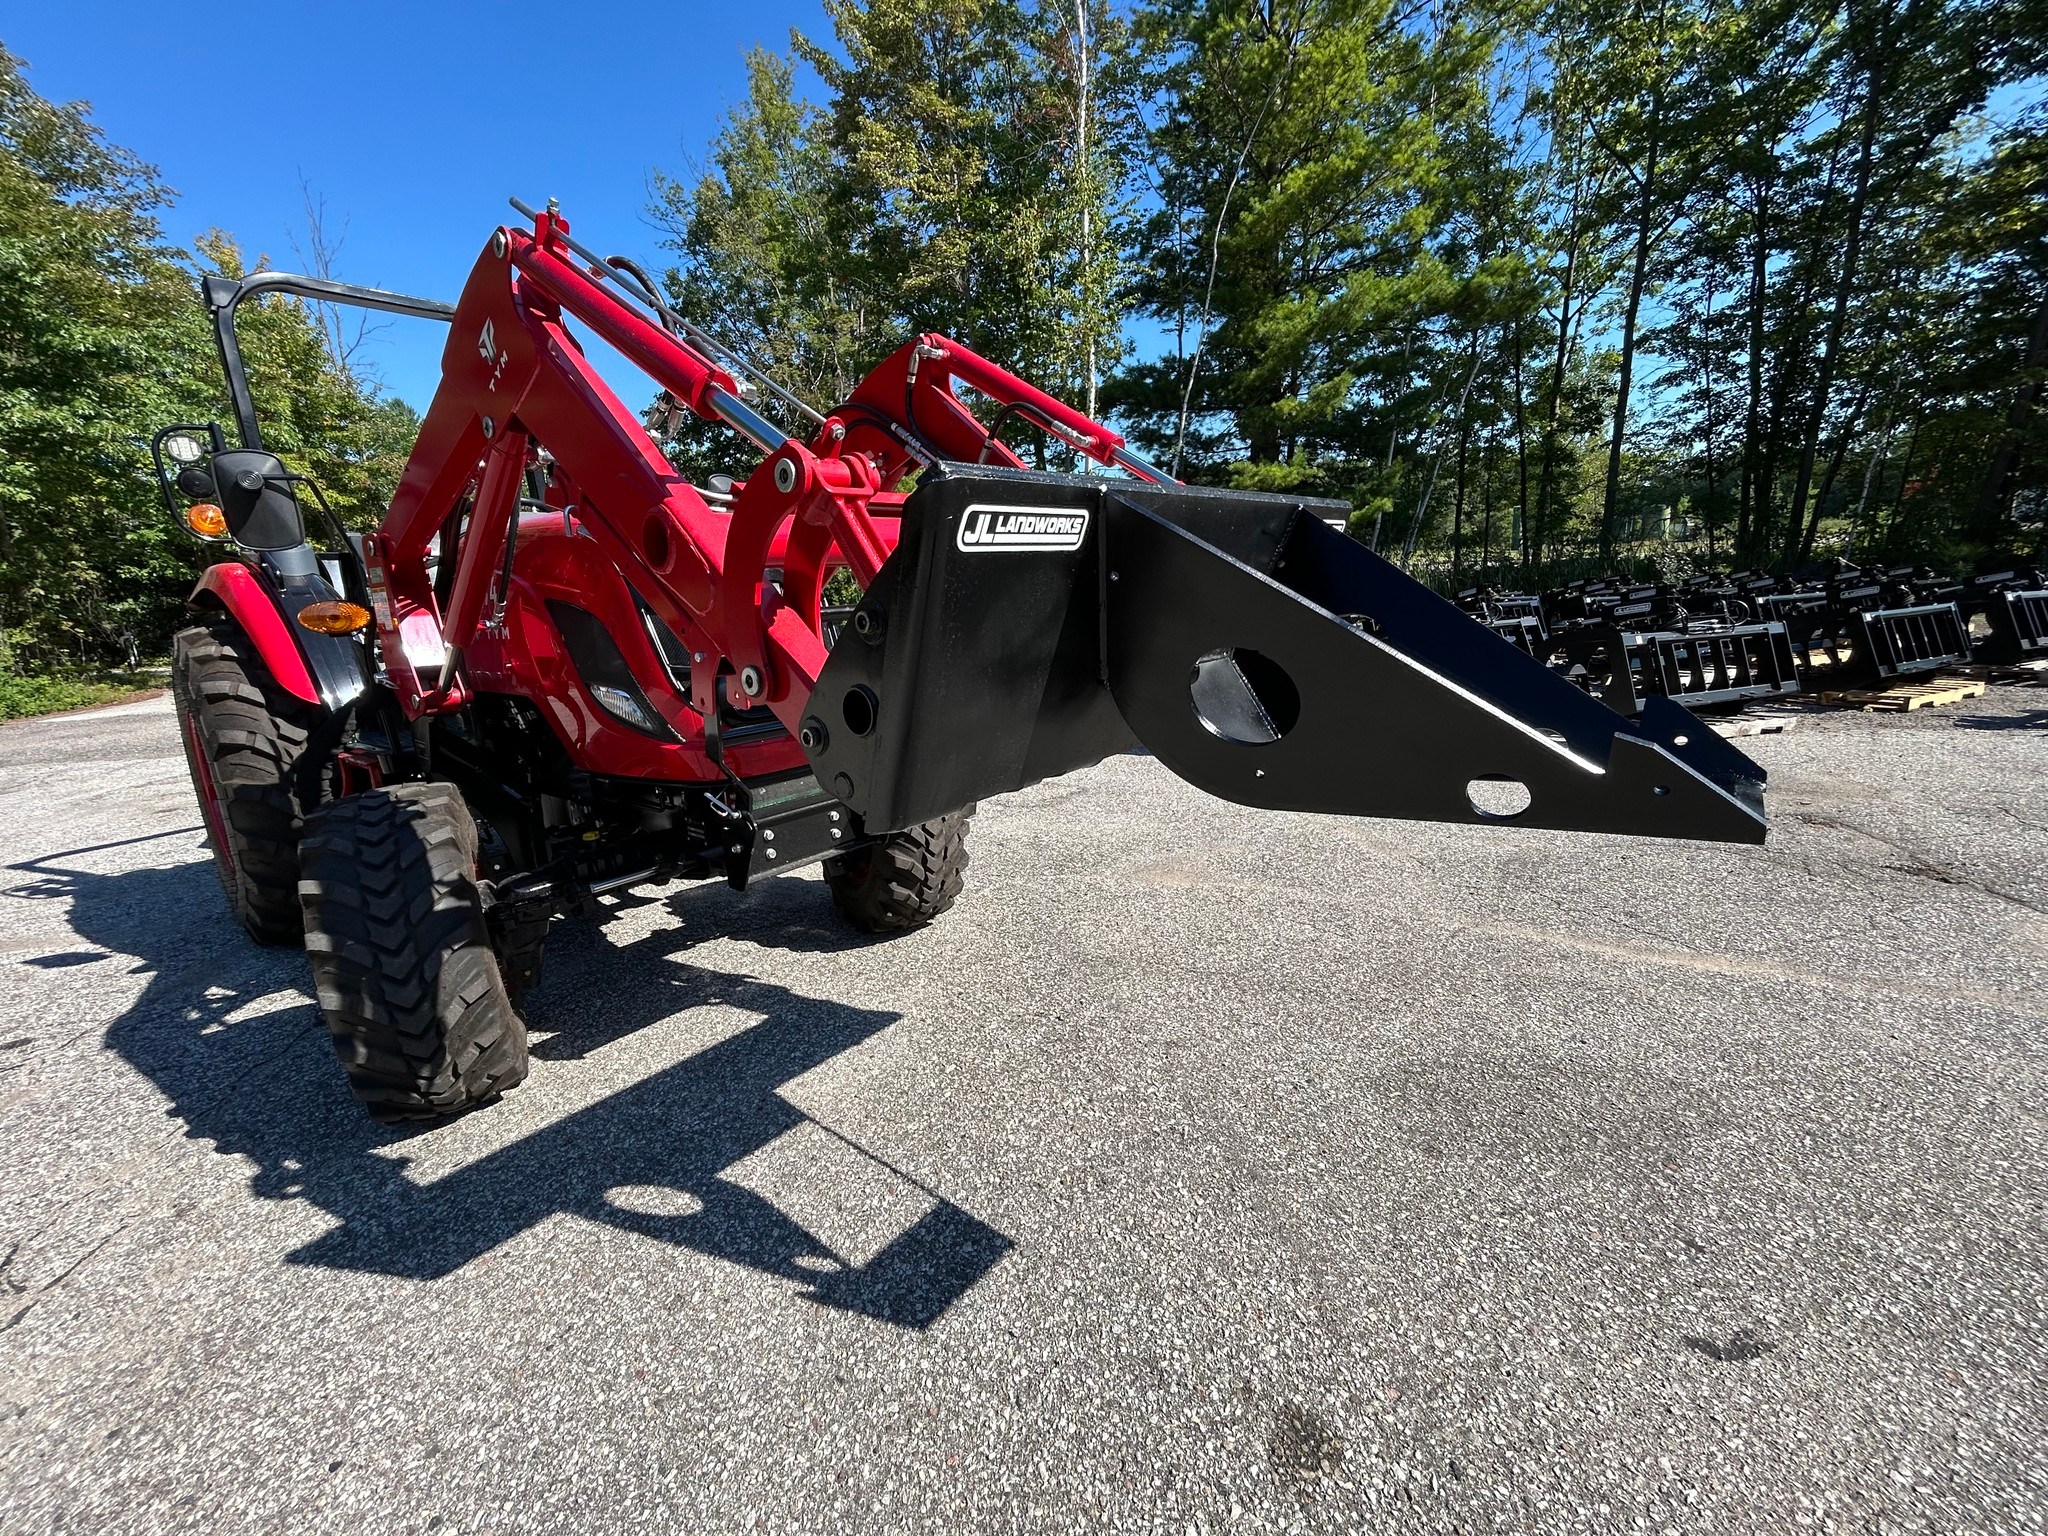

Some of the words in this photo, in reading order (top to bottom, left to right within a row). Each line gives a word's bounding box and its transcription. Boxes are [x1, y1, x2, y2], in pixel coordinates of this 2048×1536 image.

[489, 350, 508, 392] TYM
[964, 514, 995, 543] JL
[995, 515, 1084, 534] LANDWORKS
[485, 627, 510, 640] TYM
